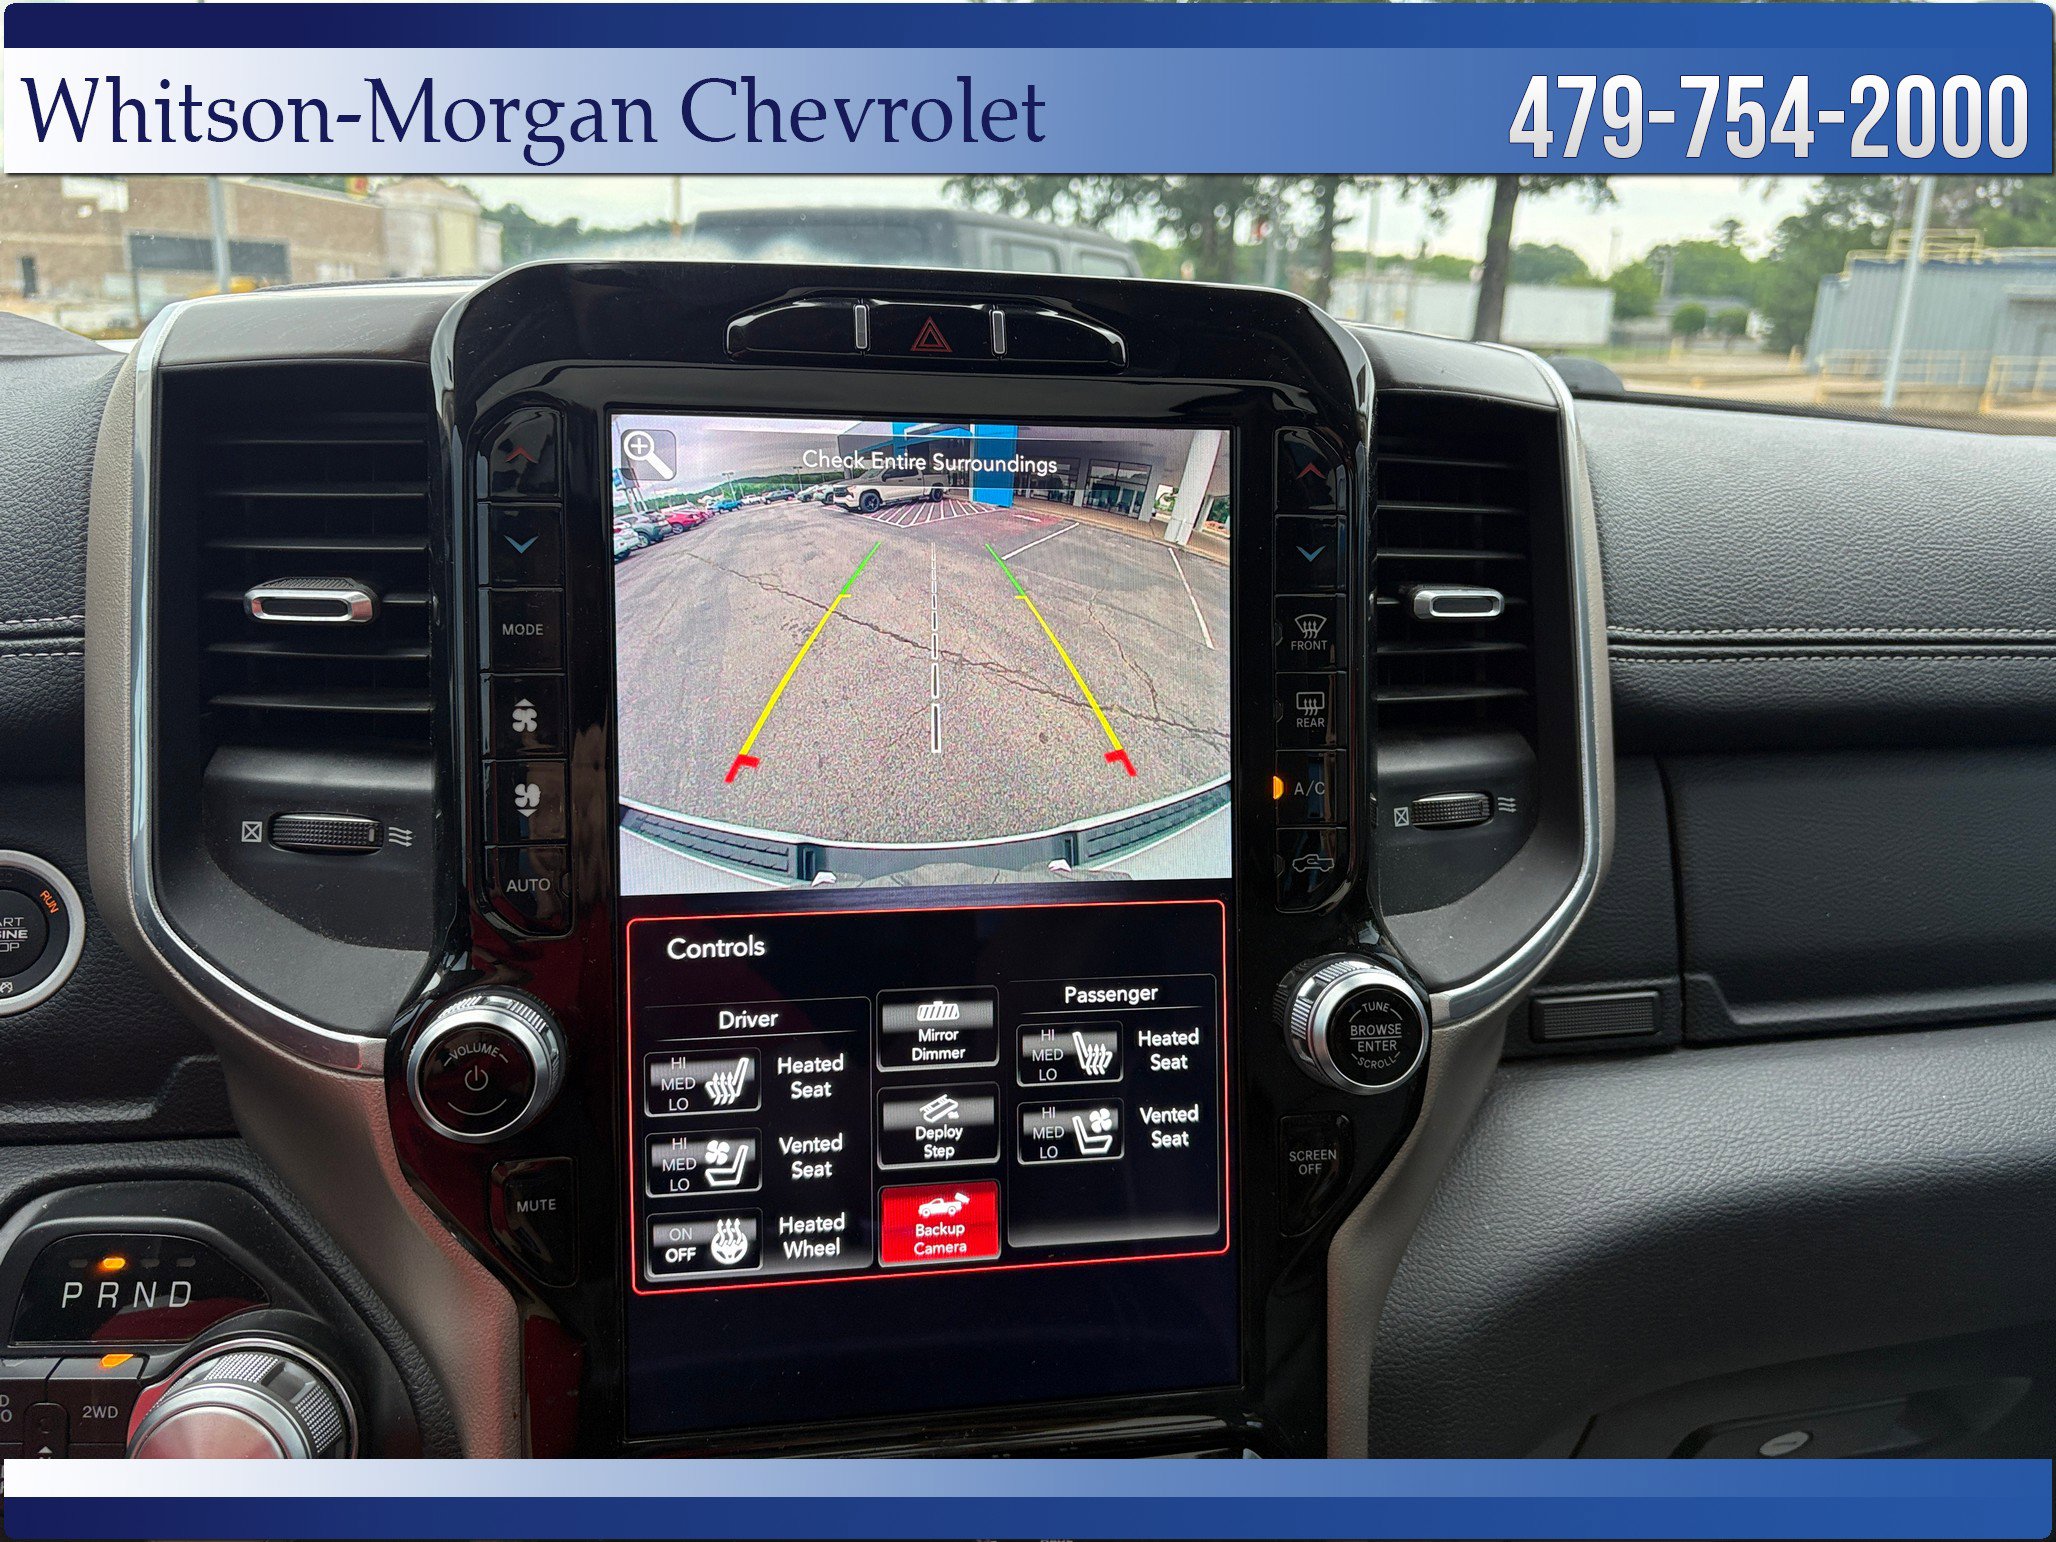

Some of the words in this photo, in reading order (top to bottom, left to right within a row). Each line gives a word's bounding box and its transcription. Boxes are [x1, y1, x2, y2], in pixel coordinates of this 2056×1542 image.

[802, 449, 865, 470] Check
[871, 451, 927, 472] Entire
[932, 452, 1058, 477] Surroundings
[501, 622, 544, 637] MODE
[1290, 639, 1328, 652] FRONT
[1295, 716, 1326, 728] REAR
[1293, 779, 1326, 797] A/C
[505, 876, 551, 894] AUTO
[39, 889, 60, 914] RUN
[666, 934, 766, 961] Controls
[1064, 985, 1160, 1006] Passenger
[1361, 1001, 1390, 1013] TUNE
[718, 1009, 779, 1030] Driver
[918, 1028, 960, 1044] Mirror
[1040, 1029, 1056, 1042] HI
[1137, 1027, 1200, 1048] Heated
[1350, 1023, 1402, 1037] BROWSE
[448, 1042, 501, 1060] VOLUME
[911, 1046, 967, 1062] Dimmer
[1357, 1040, 1398, 1053] ENTER
[670, 1056, 687, 1070] HI
[1031, 1048, 1065, 1063] MED
[1150, 1053, 1189, 1072] Seat
[1356, 1056, 1397, 1070] SCROLL
[777, 1051, 845, 1077] Heated
[1038, 1068, 1059, 1082] LO
[660, 1076, 697, 1092] MED
[790, 1080, 833, 1101] Seat
[668, 1097, 690, 1112] LO
[1041, 1106, 1057, 1120] HI
[1139, 1103, 1200, 1126] Vented
[915, 1125, 964, 1144] Deploy
[1032, 1126, 1066, 1140] MED
[1150, 1129, 1190, 1150] Seat
[672, 1137, 688, 1151] HI
[778, 1131, 844, 1157] Vented
[923, 1143, 956, 1161] Step
[1039, 1145, 1060, 1160] LO
[1288, 1149, 1338, 1163] SCREEN
[661, 1157, 698, 1173] MED
[791, 1159, 834, 1181] Seat
[1298, 1163, 1323, 1176] OFF
[669, 1177, 691, 1193] LO
[516, 1198, 557, 1213] MUTE
[778, 1211, 846, 1237] Heated
[914, 1221, 966, 1240] Backup
[669, 1227, 693, 1242] ON
[664, 1246, 697, 1264] OFF
[782, 1236, 842, 1261] Wheel
[913, 1240, 968, 1257] Camera
[61, 1281, 83, 1309] P
[97, 1281, 119, 1309] R
[132, 1281, 157, 1308] N
[168, 1280, 192, 1308] D
[81, 1405, 119, 1419] 2WD
